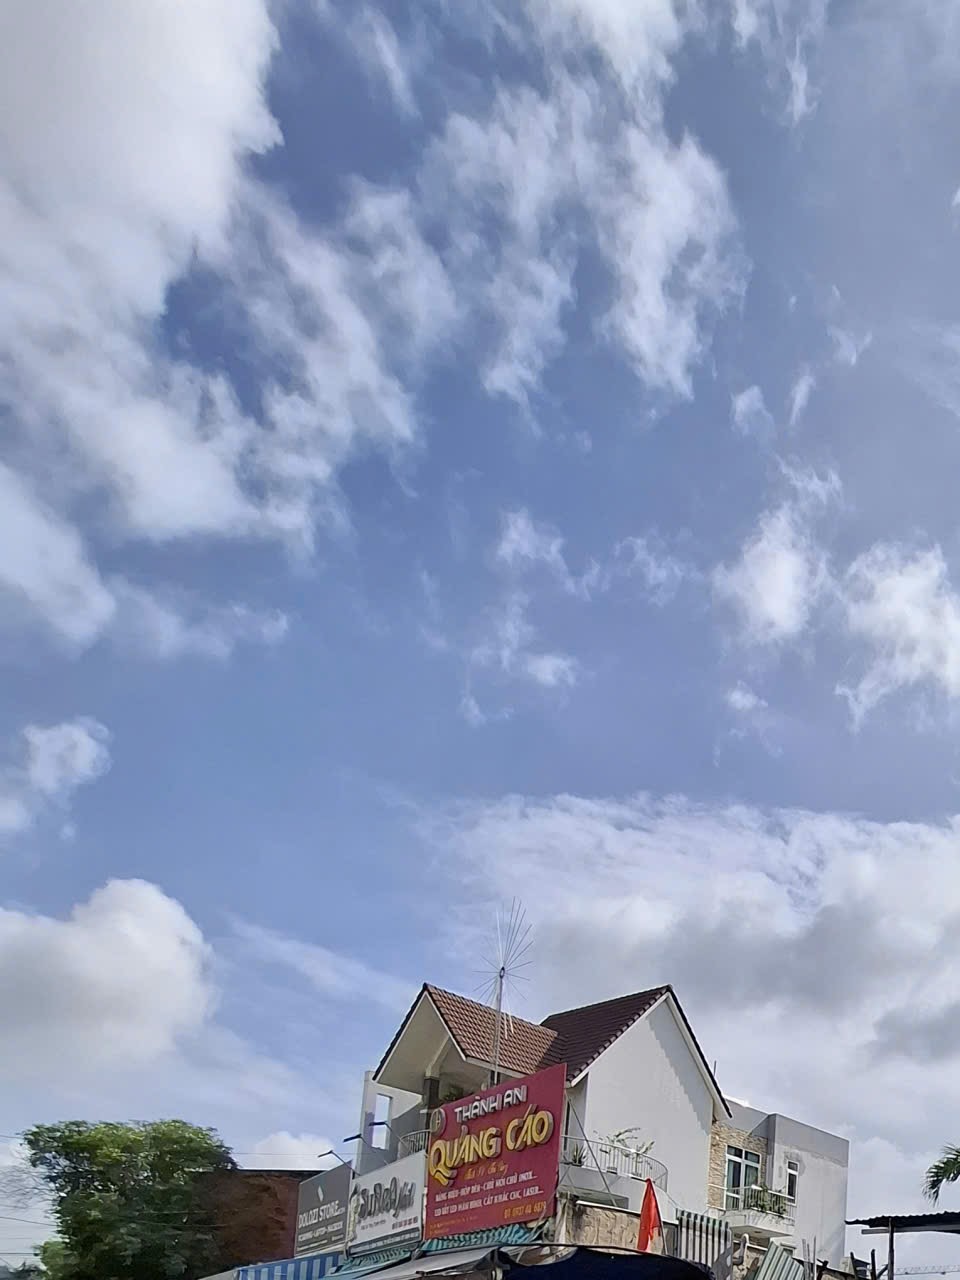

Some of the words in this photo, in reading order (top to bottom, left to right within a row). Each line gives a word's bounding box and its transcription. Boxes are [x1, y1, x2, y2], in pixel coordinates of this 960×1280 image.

[454, 1094, 502, 1123] THÀNH
[503, 1085, 528, 1107] AN
[430, 1125, 501, 1186] QUẢNG
[506, 1104, 554, 1151] CÁO
